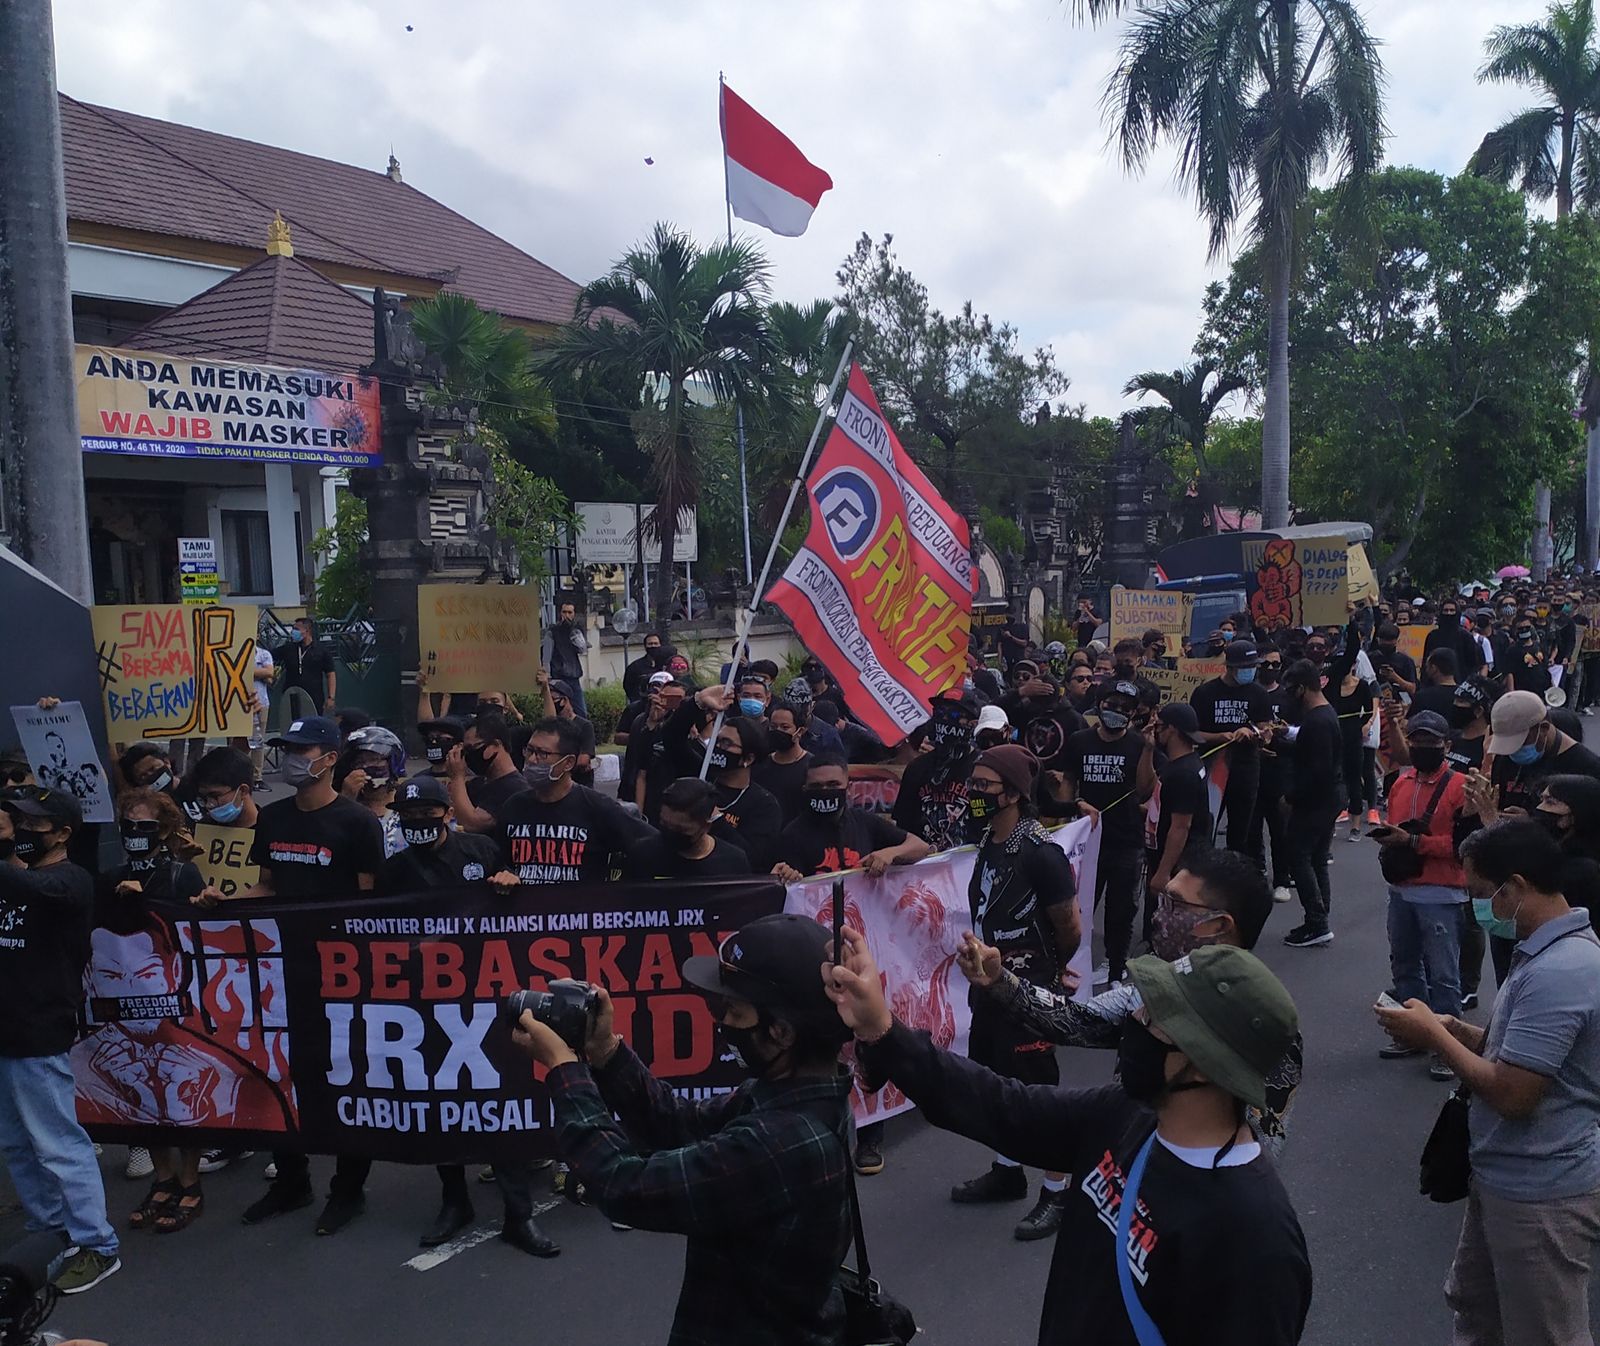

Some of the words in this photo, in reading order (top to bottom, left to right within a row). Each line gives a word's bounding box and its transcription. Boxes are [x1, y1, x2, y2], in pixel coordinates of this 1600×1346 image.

[86, 355, 179, 384] ANDA
[191, 366, 354, 401] MEMASUKI
[148, 388, 305, 420] KAWASAN
[100, 410, 212, 440] WAJIB
[223, 421, 349, 448] MASKER
[843, 401, 889, 460] FRONT
[81, 440, 119, 450] PERGUB
[120, 441, 136, 451] NO.
[137, 443, 148, 452] 46
[149, 443, 164, 453] TH.
[166, 444, 186, 454] 2020
[195, 445, 223, 456] TIDAK
[225, 449, 251, 457] PAKAI
[253, 450, 291, 459] MASKER
[292, 452, 321, 461] DENDA
[323, 453, 337, 463] Rp.
[339, 455, 369, 464] 100.000
[182, 541, 210, 551] TAMU
[1303, 548, 1348, 564] DIALOG
[1303, 568, 1314, 580] IS
[1317, 567, 1347, 580] DEAD
[1115, 593, 1177, 607] UTAMAKAN
[1115, 609, 1177, 625] SUBSTANSI
[119, 608, 188, 649] SAYA
[122, 651, 194, 679] BERSAMA
[109, 677, 196, 722] BEBASKAN
[1219, 701, 1249, 709] BELIEVE
[1083, 755, 1087, 764] I
[1088, 755, 1126, 765] BELIEVE
[1083, 765, 1092, 773] IN
[1093, 765, 1110, 774] SITI
[406, 784, 420, 799] R
[404, 827, 438, 840] BALI
[536, 824, 588, 841] HARUS
[511, 838, 586, 865] EDARAH
[131, 858, 156, 872] JRX
[520, 864, 580, 881] BERSAUDARA
[344, 915, 421, 935] FRONTIER
[424, 917, 460, 935] BALI
[464, 918, 475, 934] X
[479, 914, 544, 934] ALIANSI
[548, 913, 589, 931] KAMI
[593, 910, 670, 930] BERSAMA
[674, 909, 705, 927] JRX
[118, 995, 180, 1010] FREEDOM
[119, 1009, 130, 1018] of
[132, 1004, 181, 1018] SPEECH
[324, 1003, 501, 1091] JRX
[337, 1096, 430, 1134] CABUT
[440, 1097, 541, 1133] PASAL
